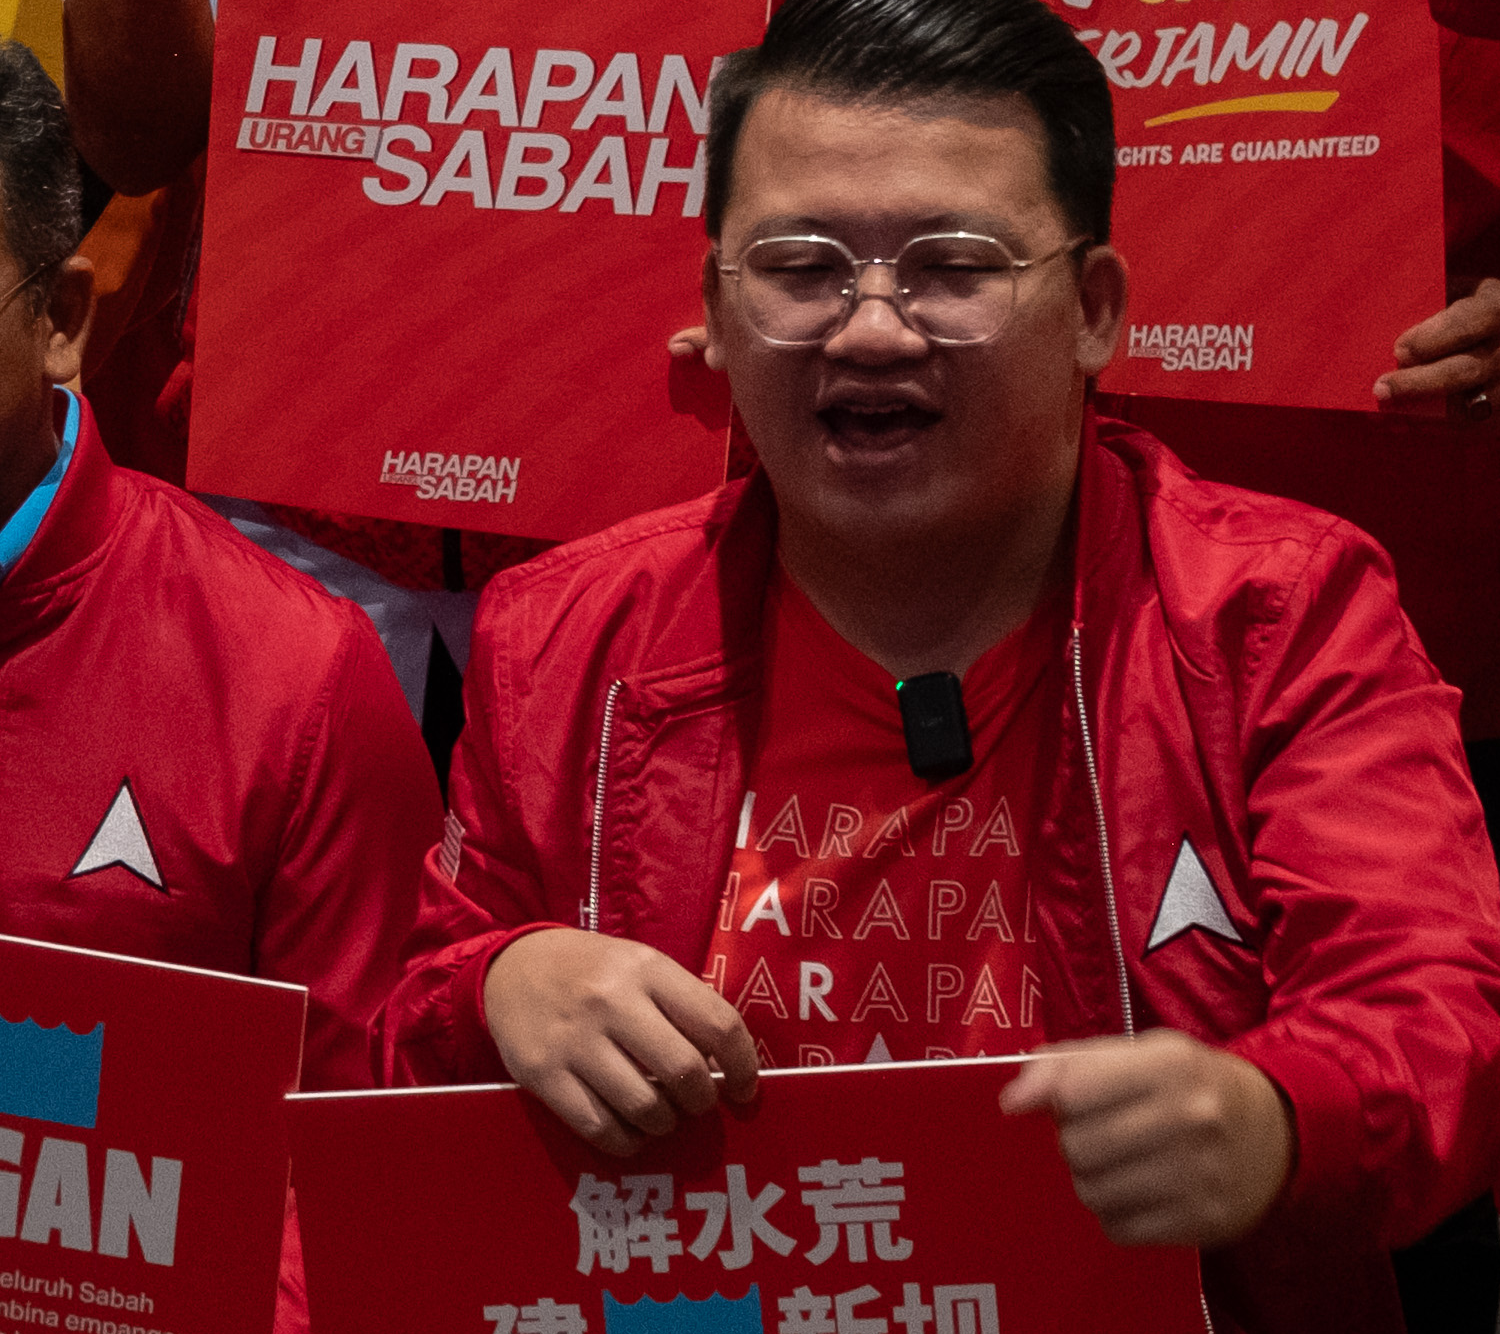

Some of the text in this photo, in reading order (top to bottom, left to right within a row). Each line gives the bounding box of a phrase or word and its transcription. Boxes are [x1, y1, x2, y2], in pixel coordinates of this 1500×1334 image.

[245, 36, 722, 137] HARAPAN
[248, 121, 706, 218] URANG SABAH
[1180, 135, 1380, 164] ARE GUARANTEED
[569, 1156, 914, 1277] 解水荒
[78, 1280, 154, 1314] Sabah
